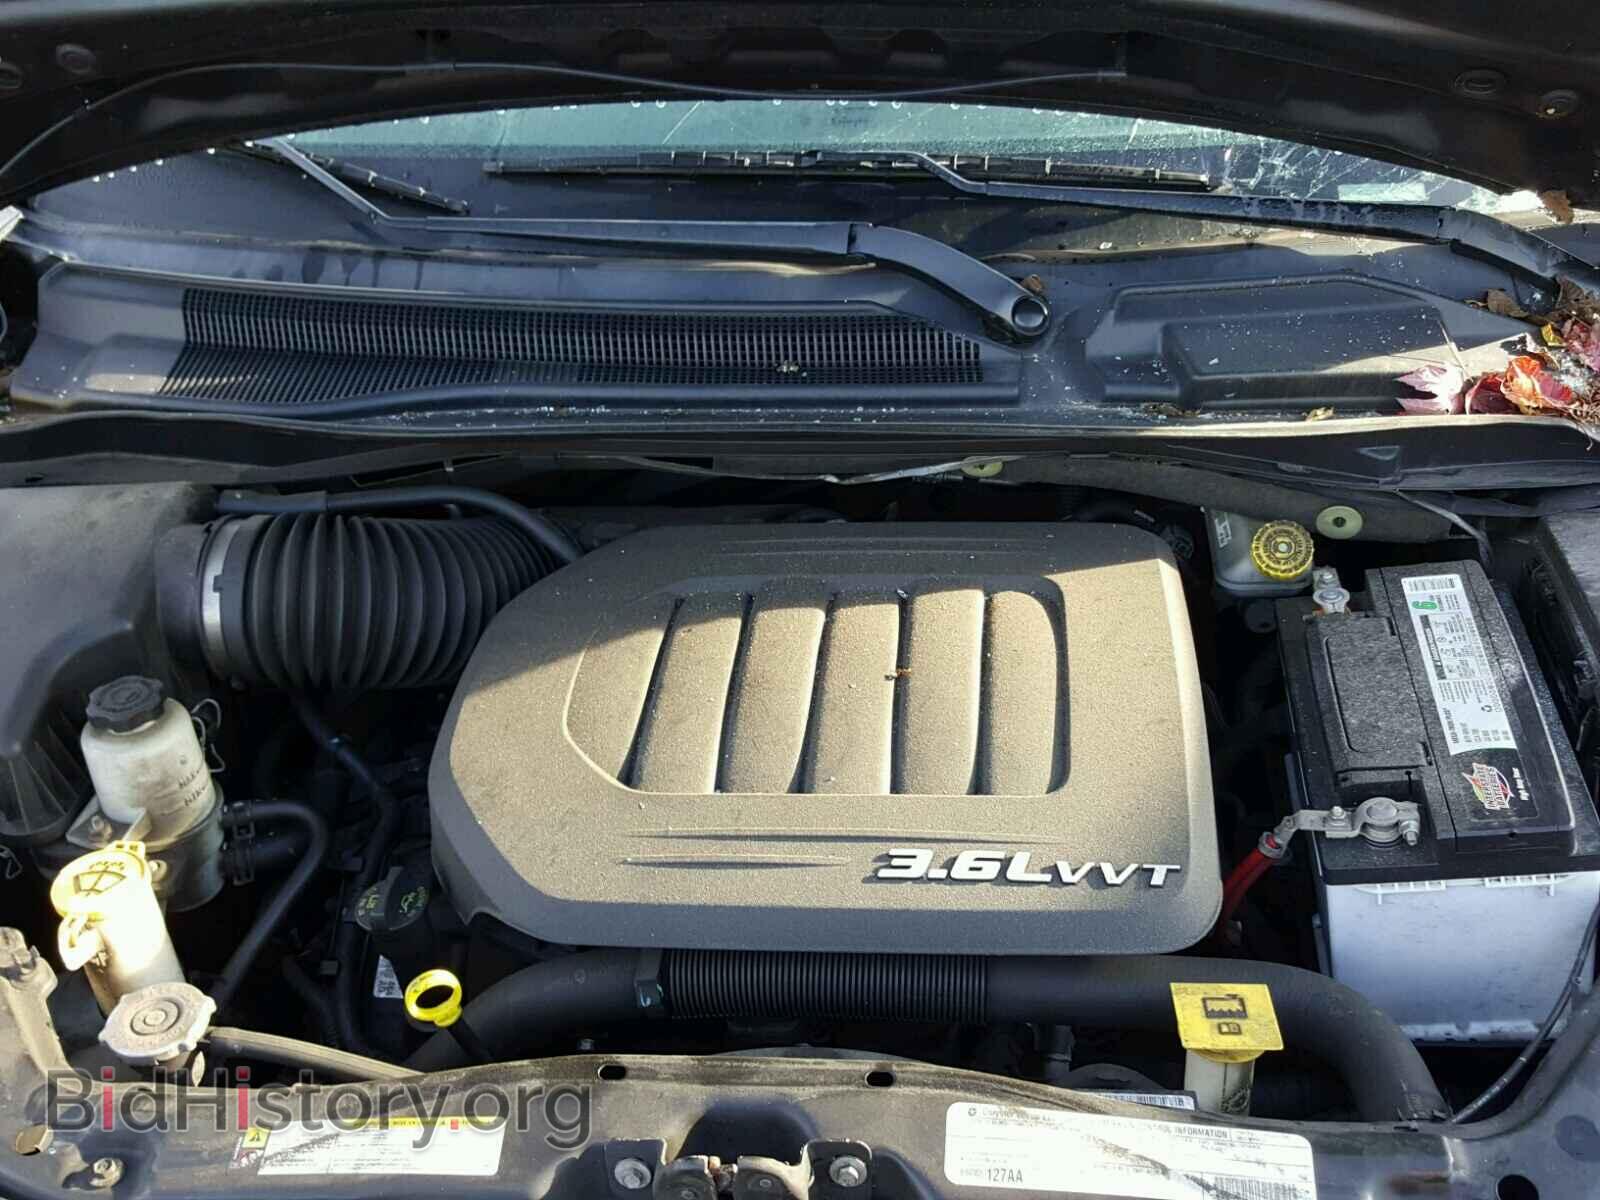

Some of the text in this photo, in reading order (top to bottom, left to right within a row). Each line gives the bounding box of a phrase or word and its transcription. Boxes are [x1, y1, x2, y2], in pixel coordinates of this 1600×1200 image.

[877, 848, 1181, 887] 3.6L VVT
[1175, 1126, 1228, 1139] INFORMATION
[987, 1167, 1024, 1184] 127AA
